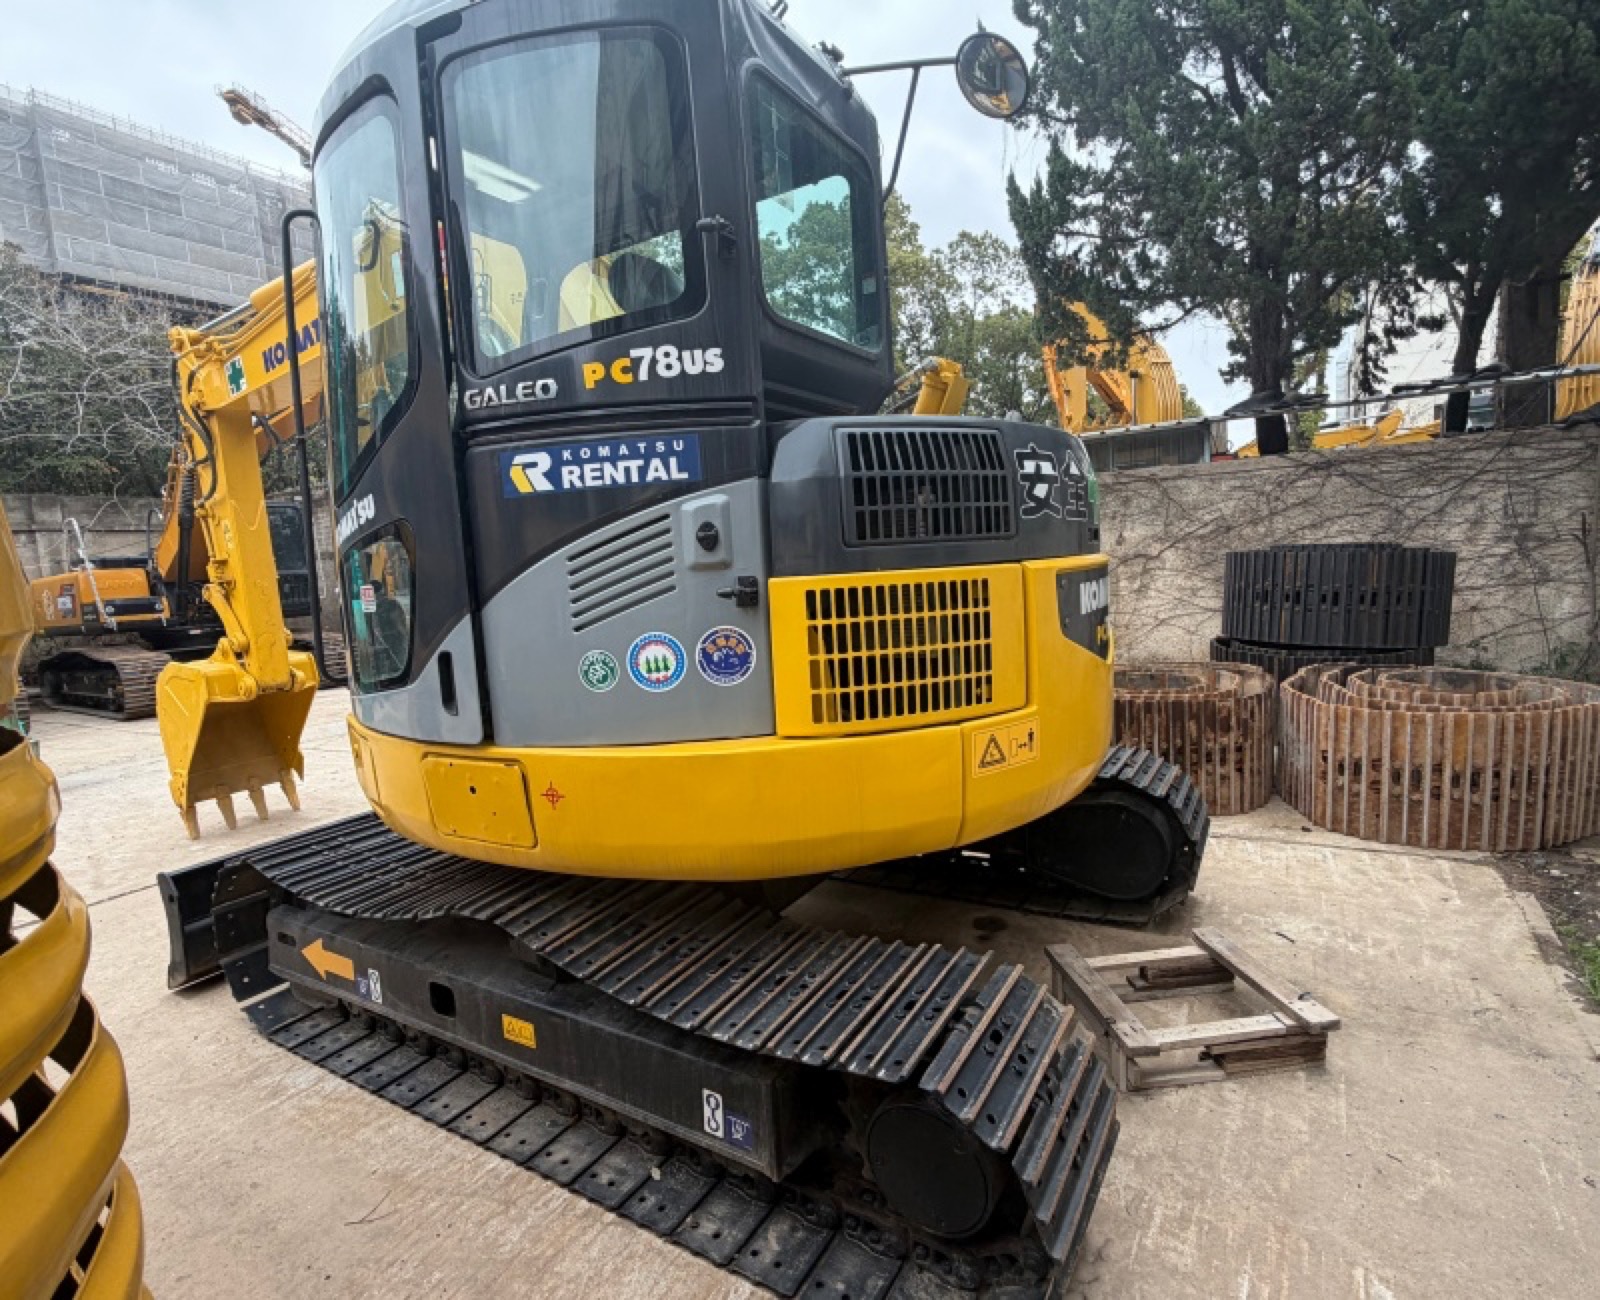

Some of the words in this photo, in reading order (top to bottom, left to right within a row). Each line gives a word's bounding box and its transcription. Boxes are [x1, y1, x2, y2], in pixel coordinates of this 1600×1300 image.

[262, 318, 320, 373] KOAT
[463, 378, 558, 409] GALEO
[562, 439, 685, 461] KOMATSU
[562, 456, 689, 489] RENTAL
